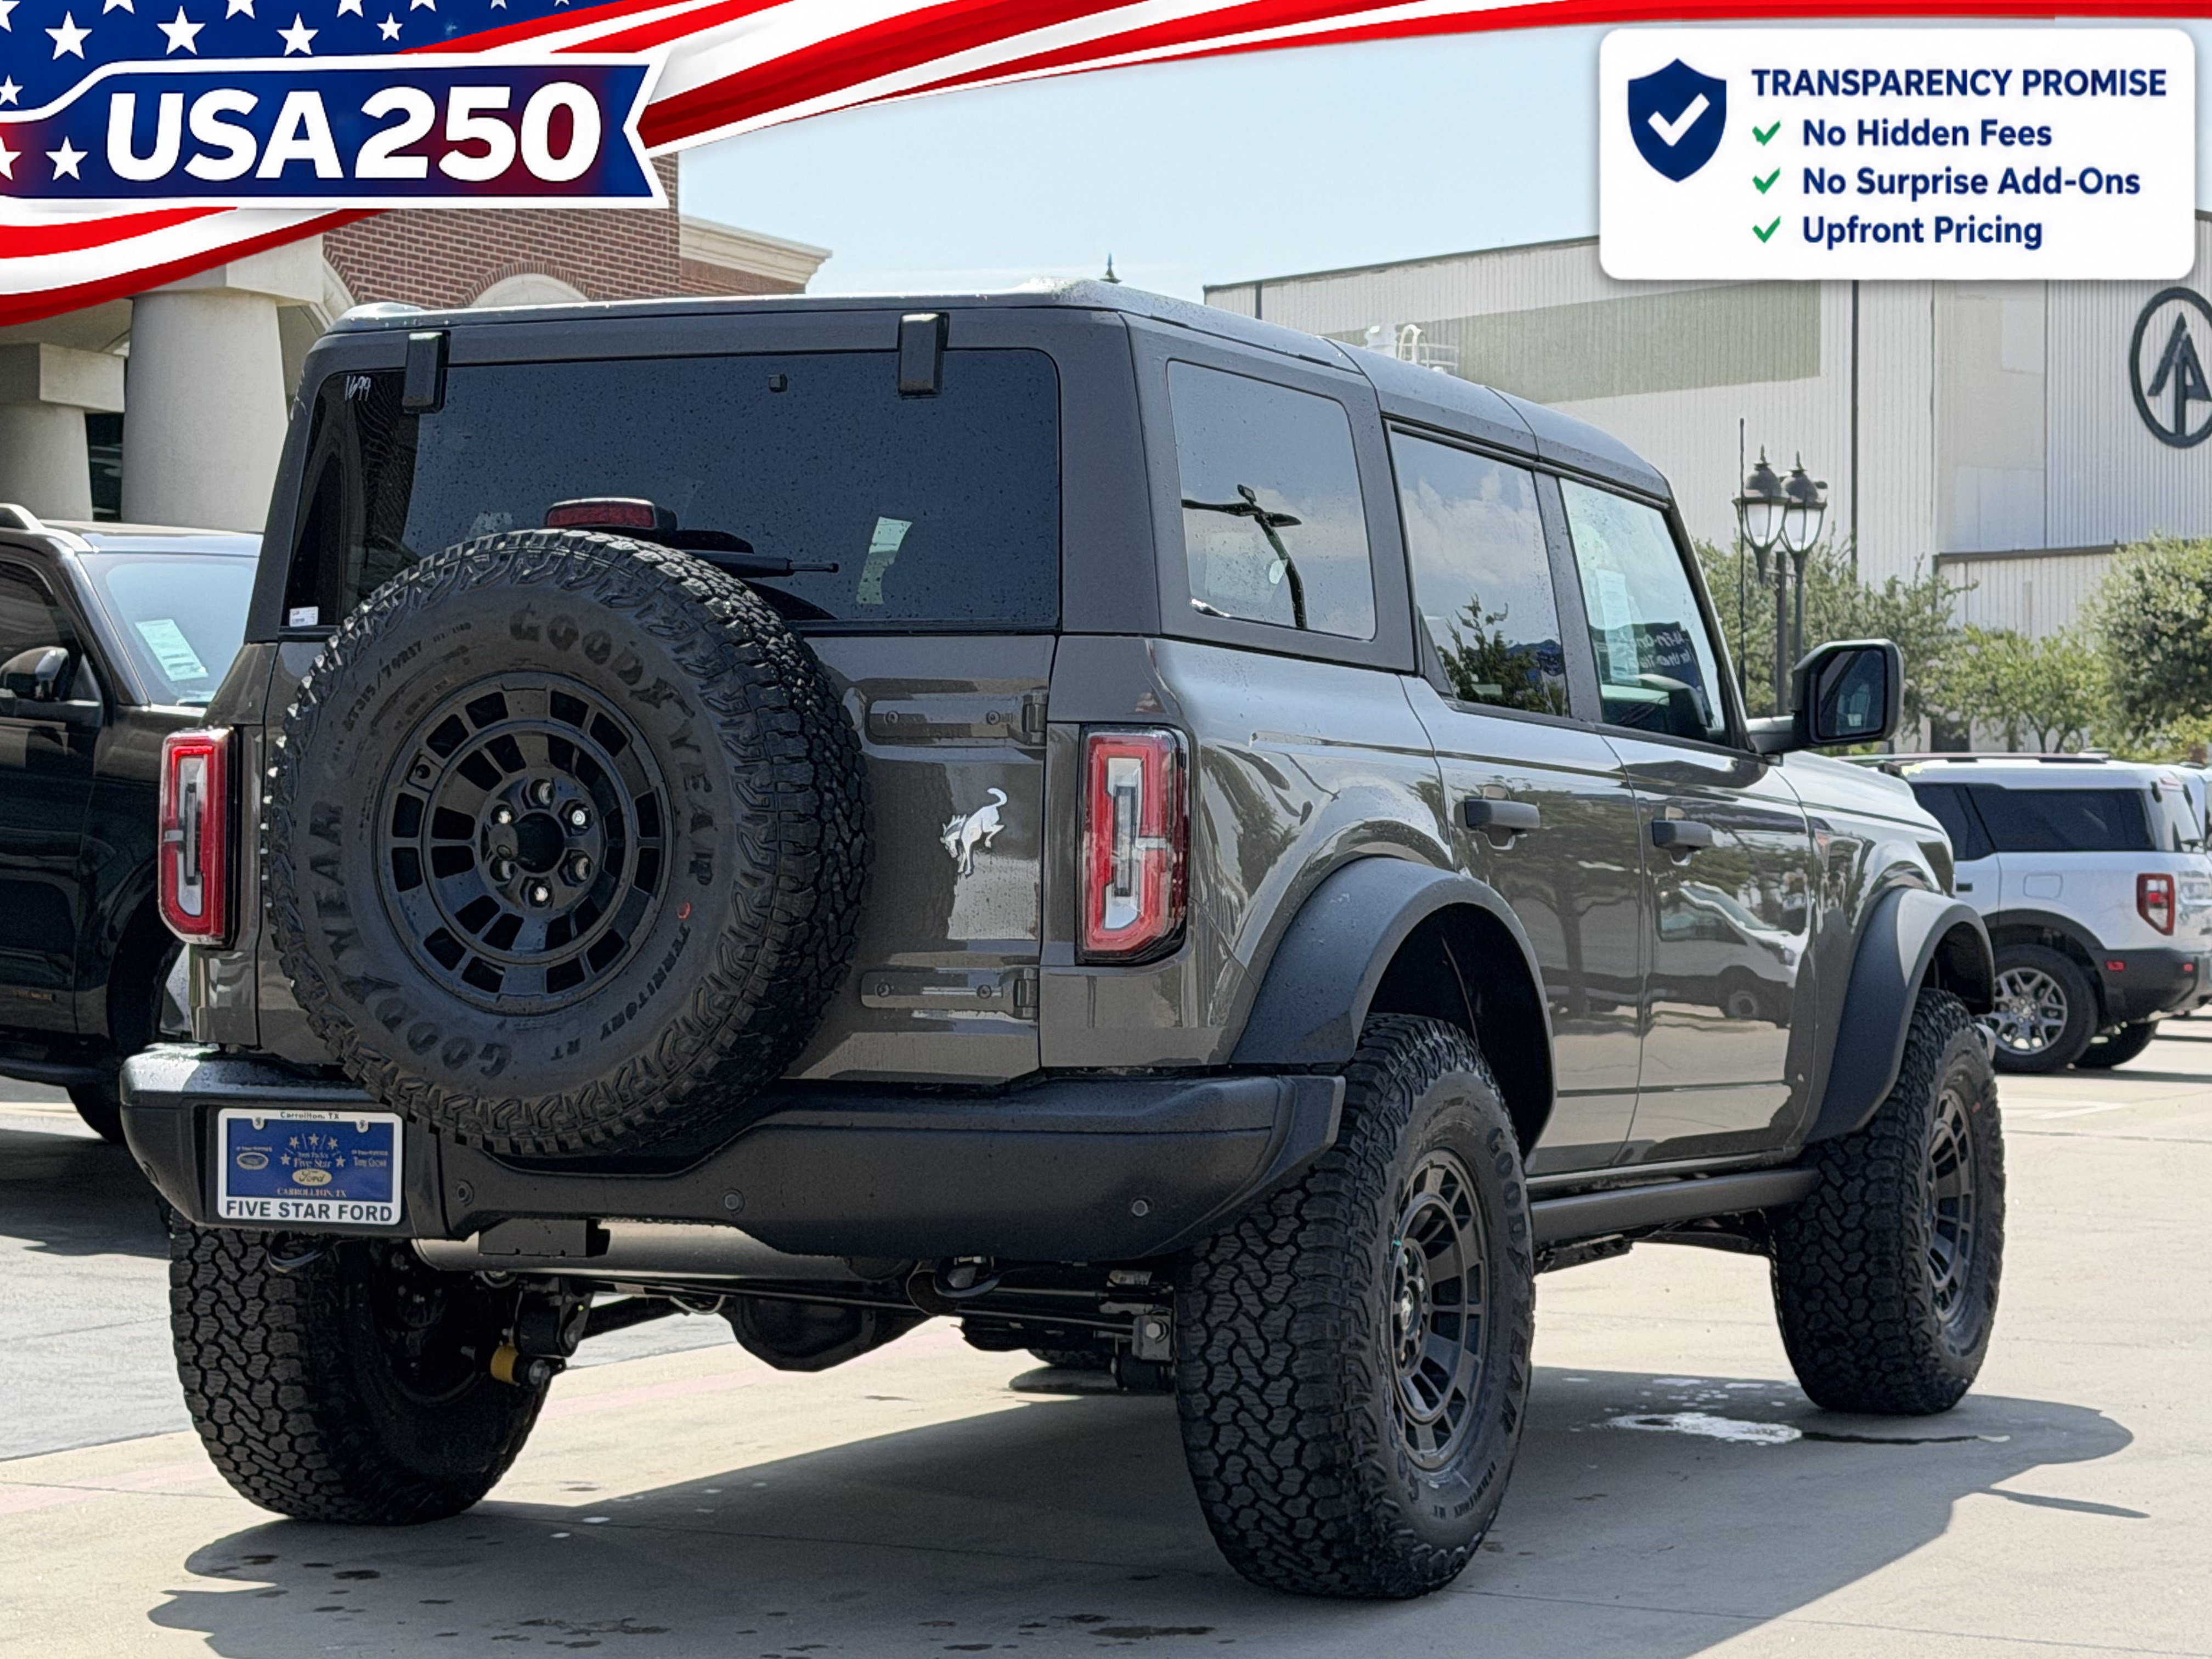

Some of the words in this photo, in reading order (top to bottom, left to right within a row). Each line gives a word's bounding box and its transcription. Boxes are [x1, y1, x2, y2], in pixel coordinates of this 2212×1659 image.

[509, 608, 714, 886] GOODYEAR
[601, 922, 691, 1041] TERRITORY
[550, 1037, 580, 1061] RT
[298, 1169, 326, 1183] Ford
[225, 1200, 272, 1217] FIVE
[278, 1201, 330, 1219] STAR
[337, 1204, 392, 1222] FORD
